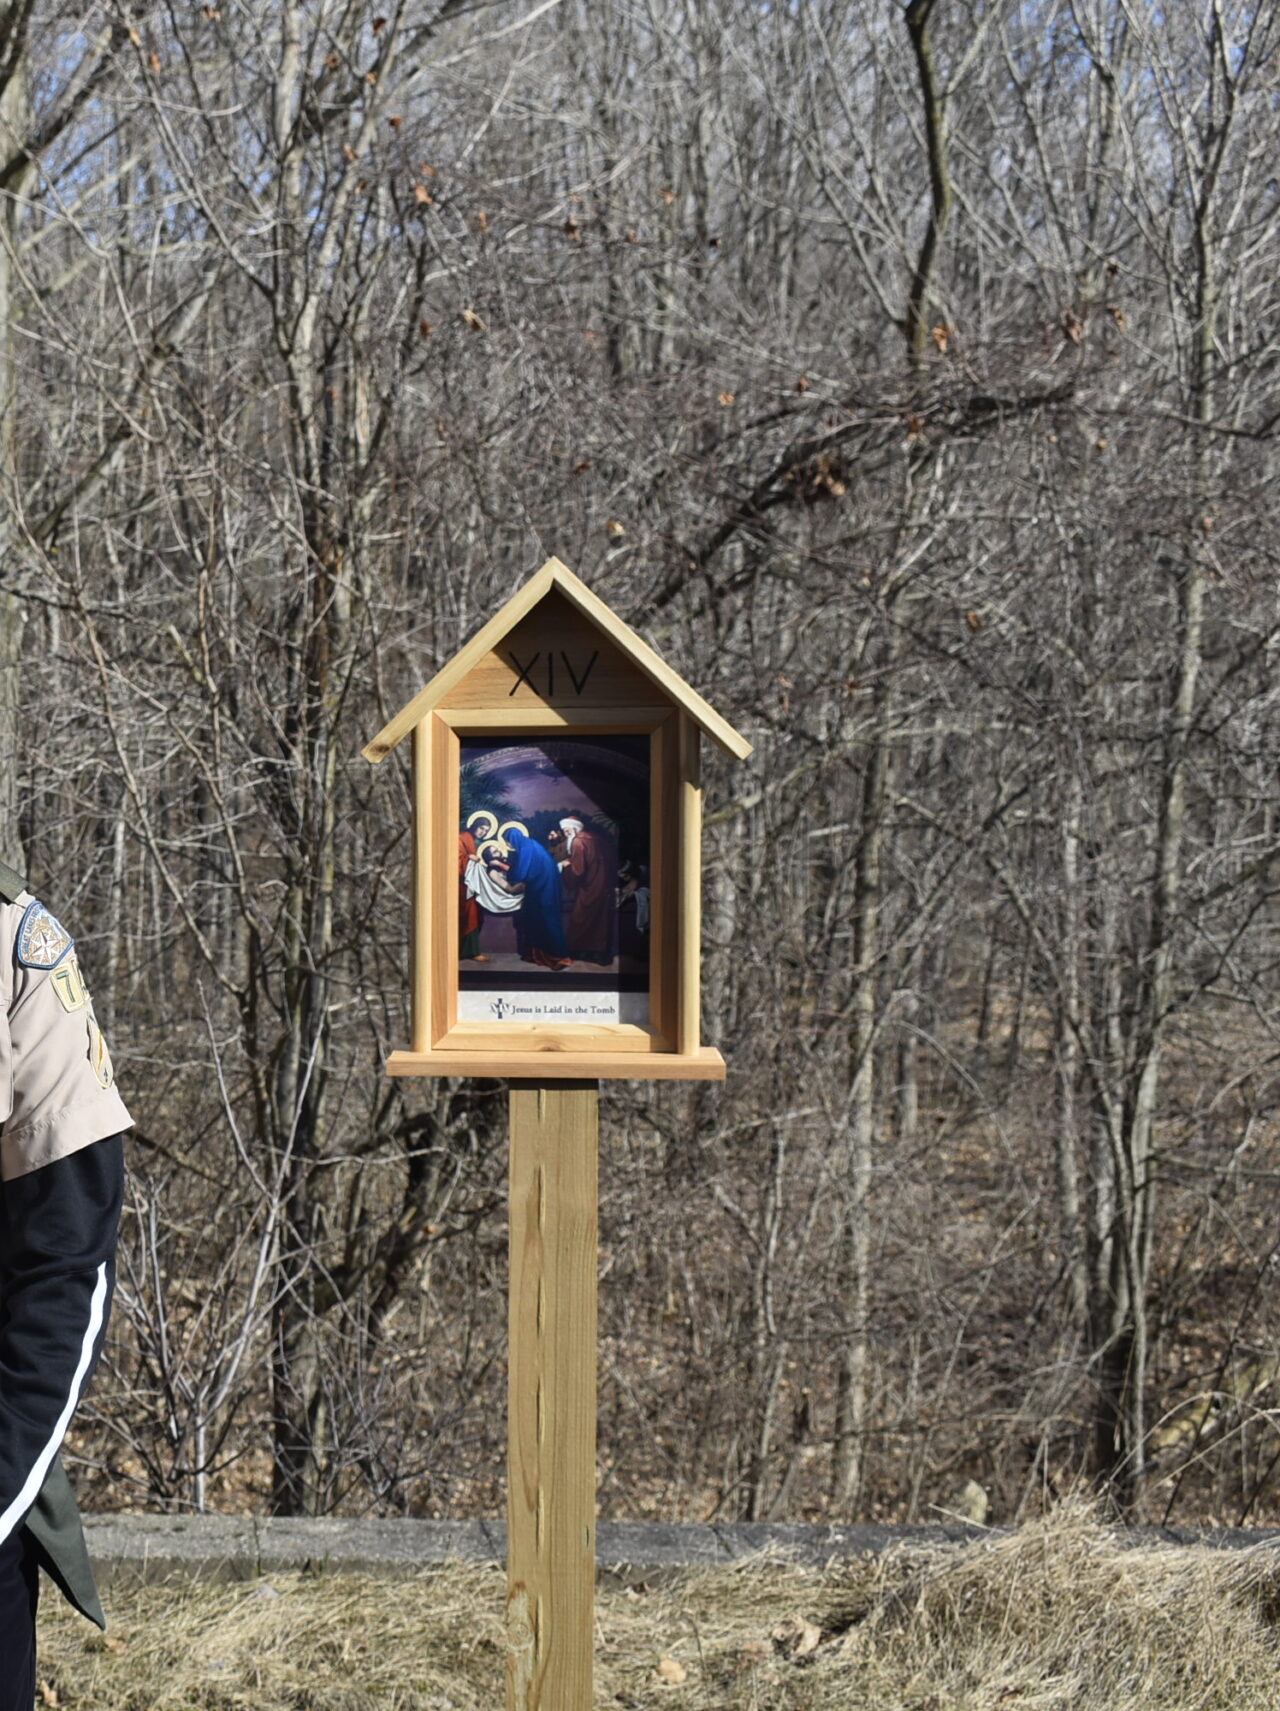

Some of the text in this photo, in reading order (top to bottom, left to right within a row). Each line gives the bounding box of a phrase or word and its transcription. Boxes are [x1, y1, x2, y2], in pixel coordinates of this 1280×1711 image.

[508, 650, 599, 697] XIV
[55, 969, 76, 1003] 7
[511, 1004, 616, 1015] Jesus is Laid in the Tomb
